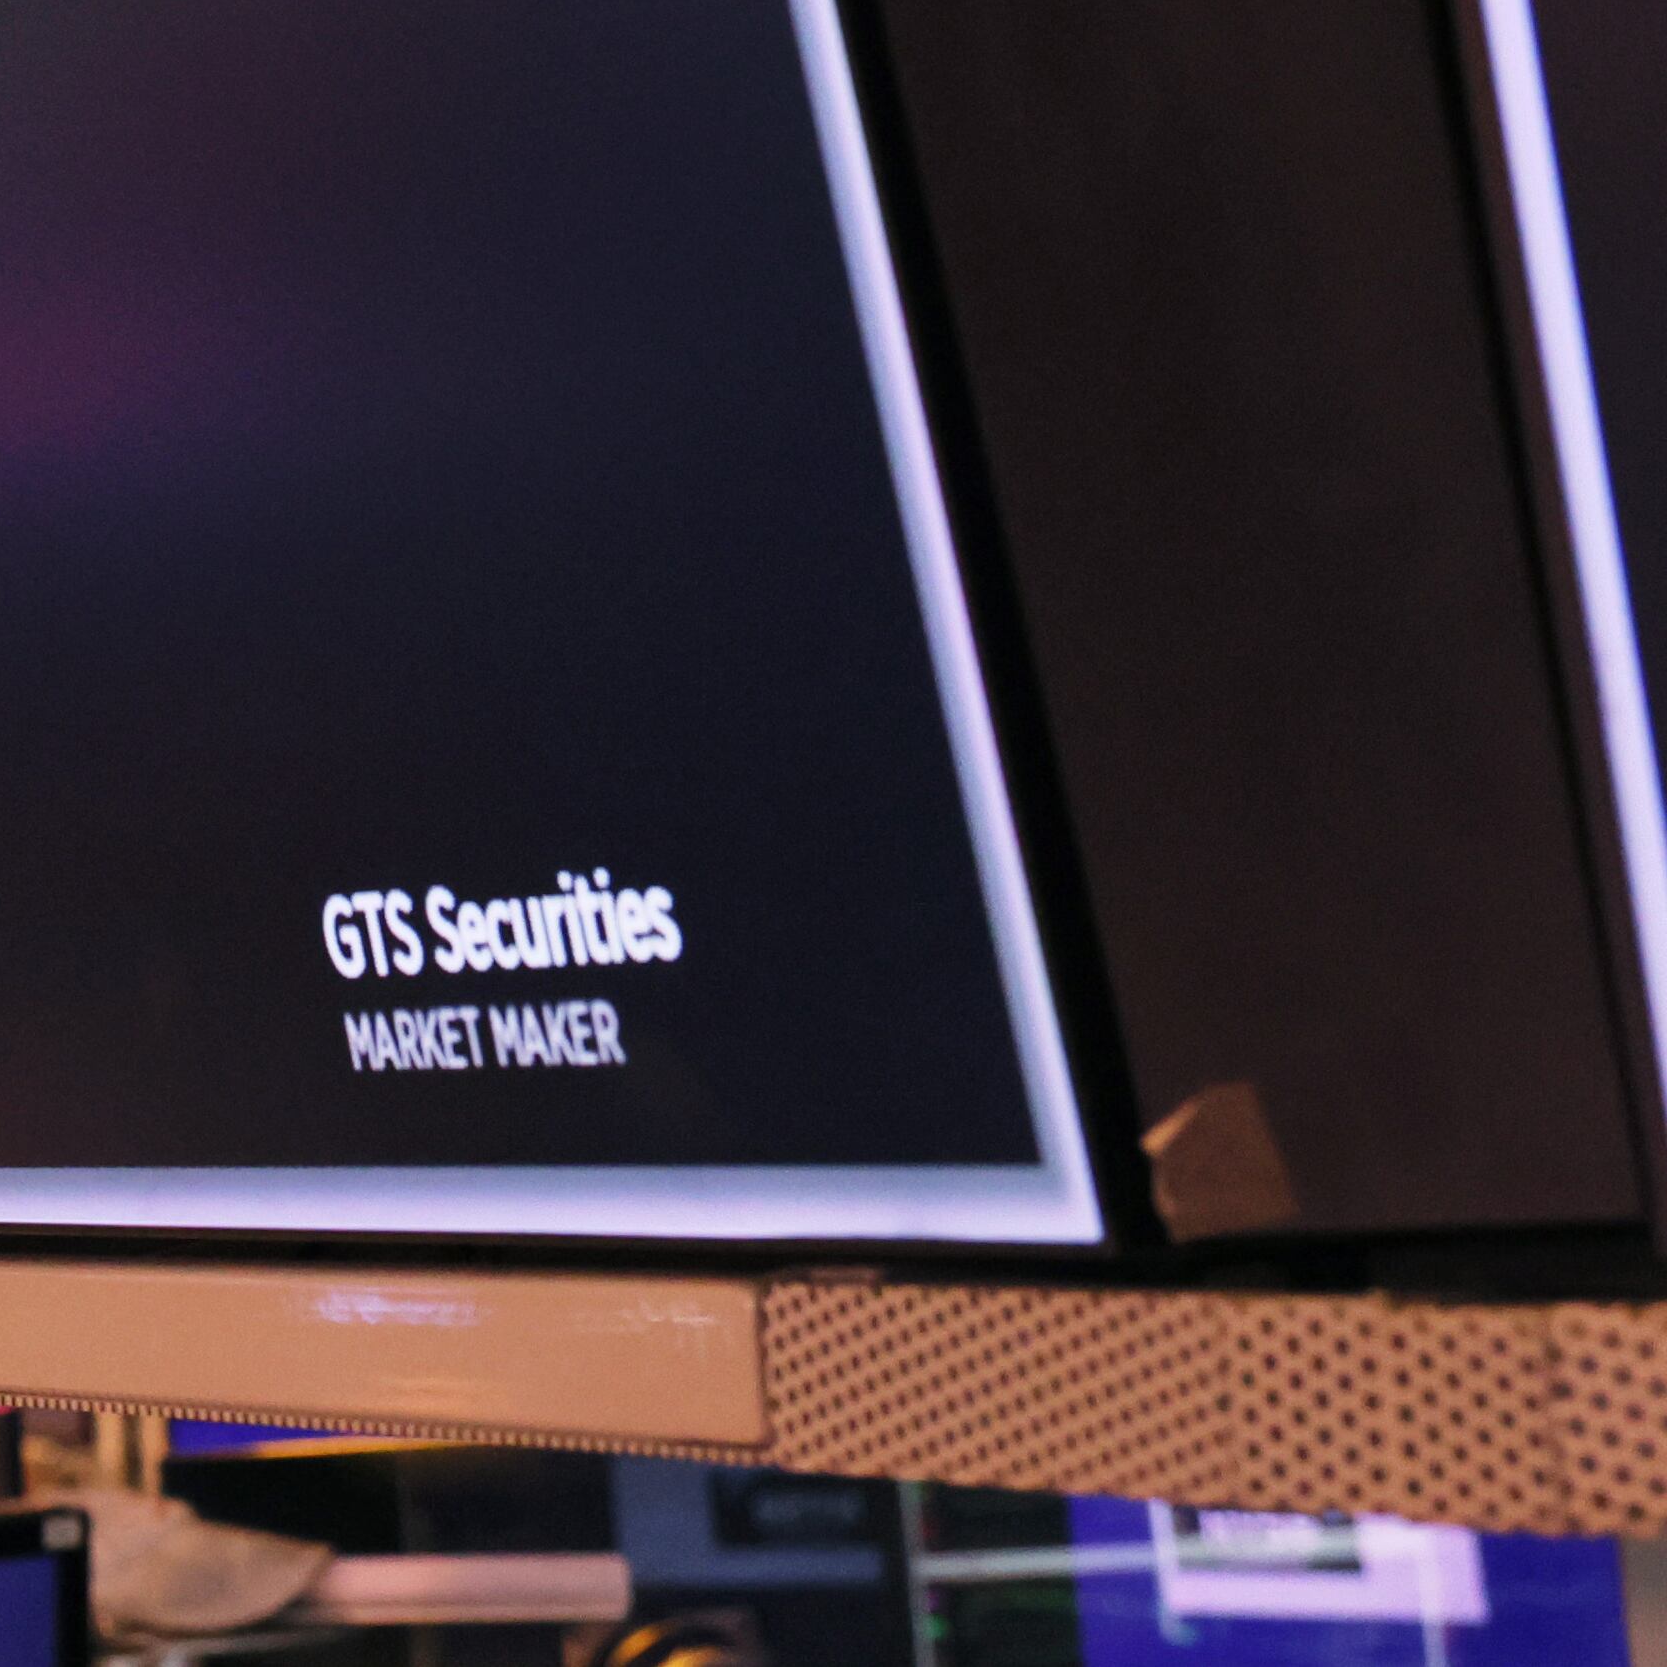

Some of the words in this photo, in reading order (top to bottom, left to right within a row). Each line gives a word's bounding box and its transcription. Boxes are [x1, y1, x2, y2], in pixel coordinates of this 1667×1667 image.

[322, 887, 425, 980] GTS
[425, 866, 683, 974] Securities
[343, 1005, 483, 1072] MARKET
[488, 998, 627, 1068] MAKER
